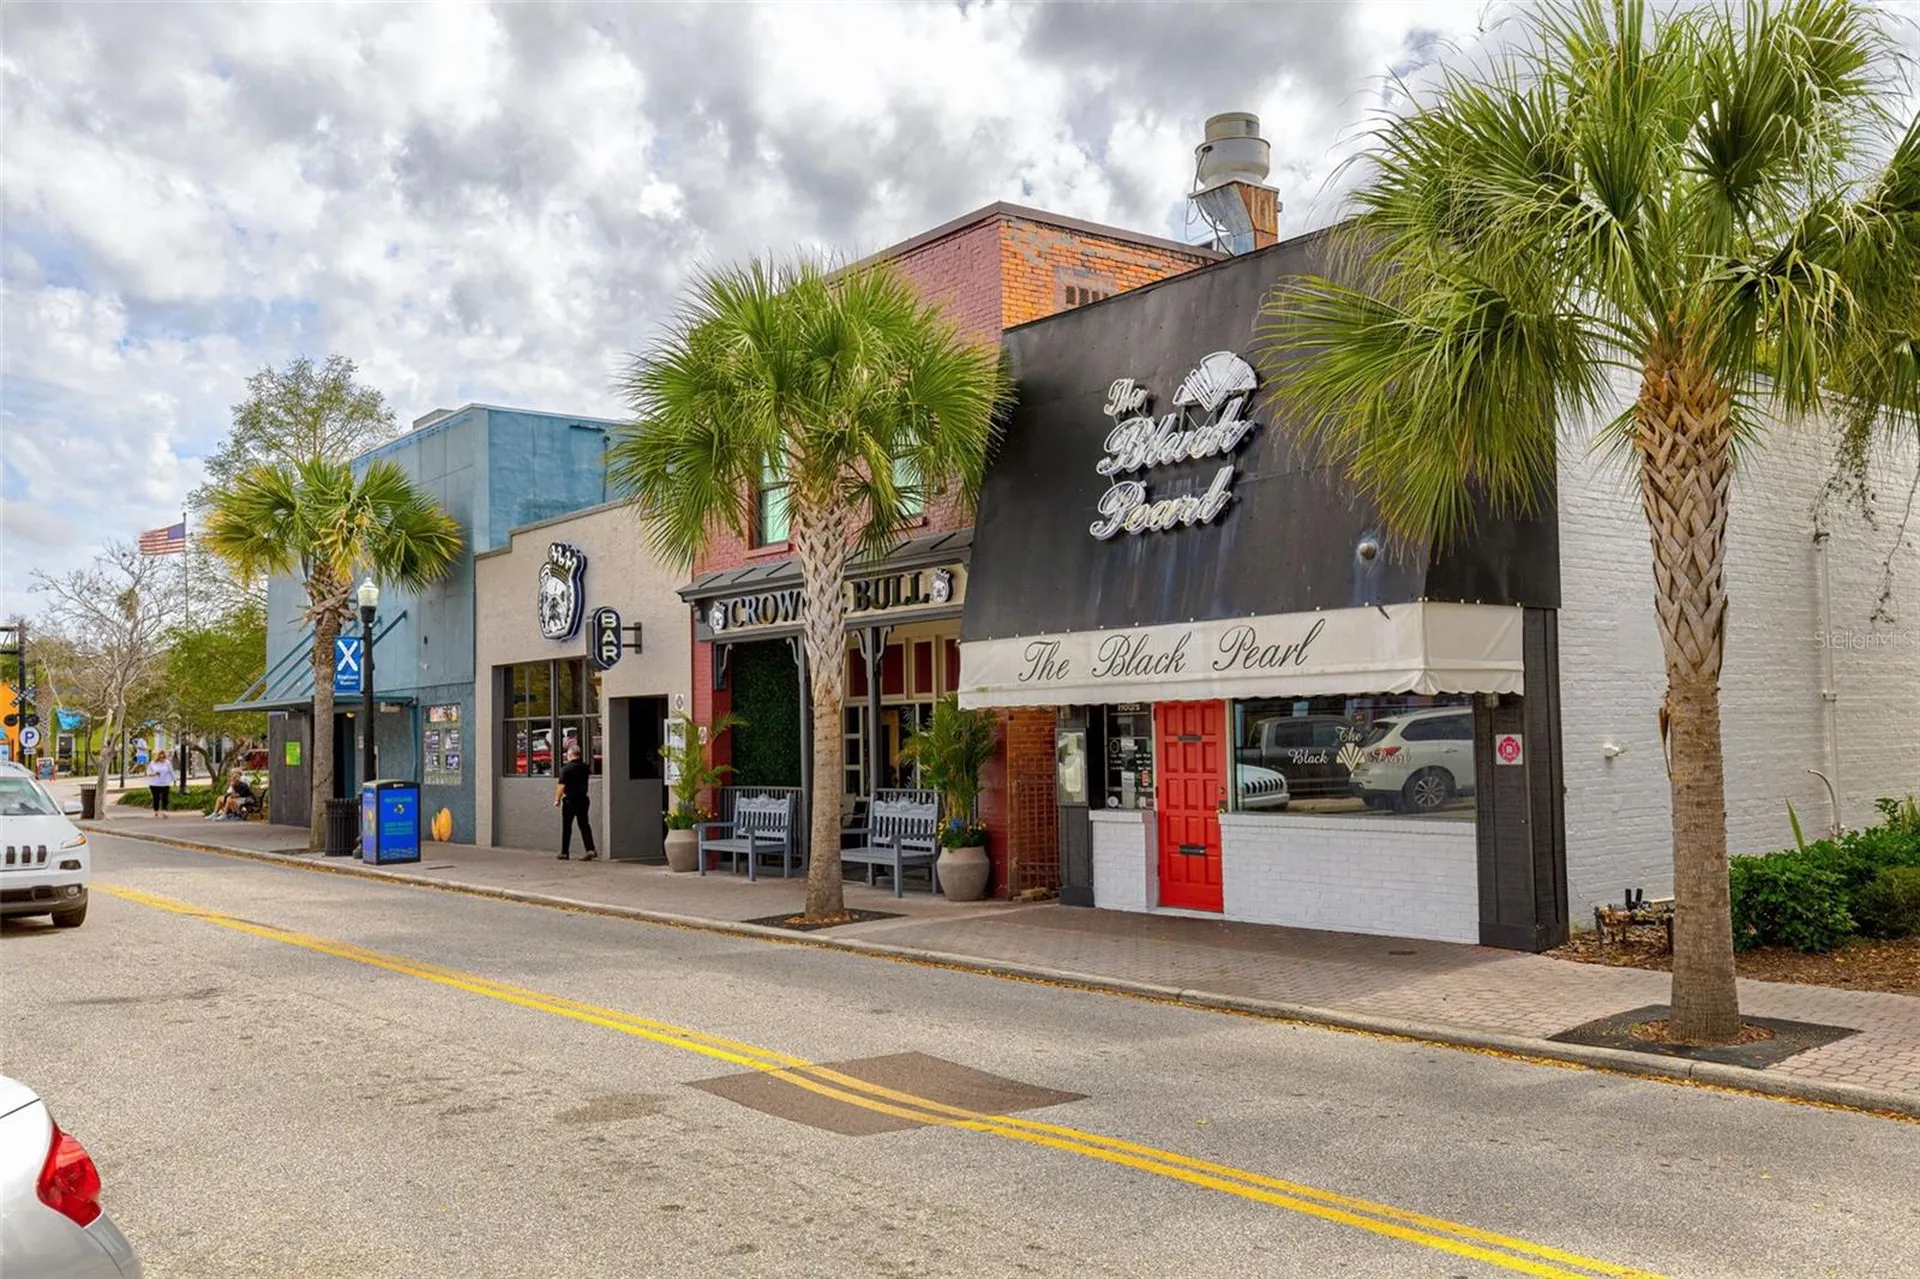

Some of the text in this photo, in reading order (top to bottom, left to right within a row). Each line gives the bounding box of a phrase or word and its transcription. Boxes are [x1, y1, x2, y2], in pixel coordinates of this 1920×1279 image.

[1103, 378, 1149, 416] The
[1096, 397, 1255, 476] Black
[1089, 465, 1235, 541] Pearl
[851, 571, 930, 613] BULL
[601, 612, 617, 661] BAR
[1017, 618, 1326, 683] The Black Pearl
[25, 731, 35, 744] P
[1335, 726, 1364, 742] The
[1288, 748, 1329, 764] Black
